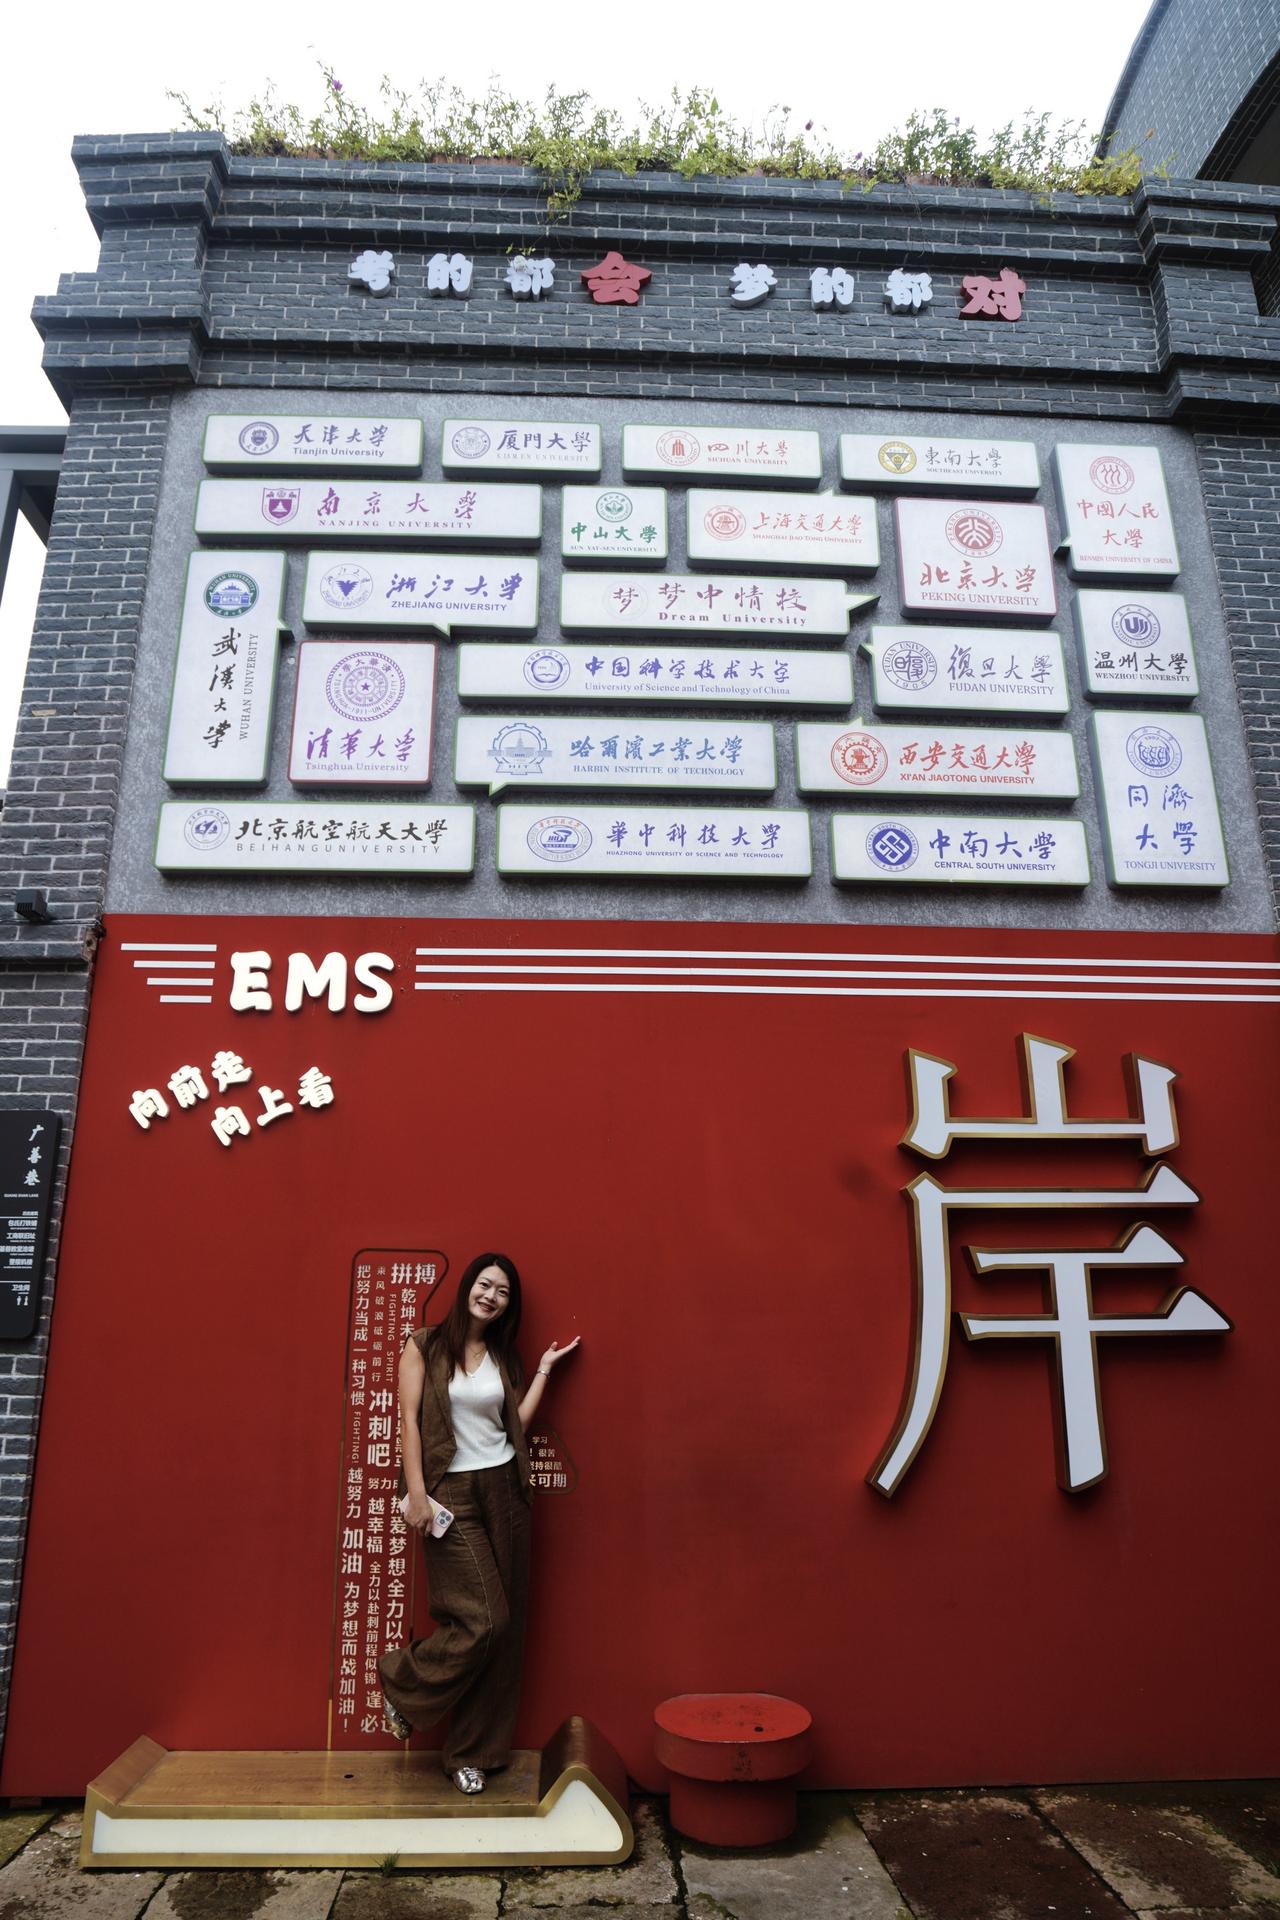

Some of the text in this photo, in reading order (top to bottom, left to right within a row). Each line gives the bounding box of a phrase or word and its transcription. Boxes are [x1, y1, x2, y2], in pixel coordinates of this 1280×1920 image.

[293, 447, 384, 458] Tianjin University
[707, 456, 788, 466] SICHUAN UNIVERSITY
[319, 519, 474, 529] NANJING UNIVERSITY
[391, 600, 507, 612] ZHEJIANG UNIVERSITY
[658, 582, 808, 611] 梦中情校
[921, 591, 1040, 607] PEKING UNIVERSITY
[658, 612, 806, 627] Dream University
[1095, 672, 1191, 682] WENZHOU UNIVERSITY
[239, 633, 260, 741] WUHAN UNIVERSITY
[585, 681, 790, 696] University of Science and Technology of China
[949, 682, 1055, 696] FUDAN UNIVERSITY
[305, 762, 410, 773] Tsinghua University
[573, 764, 745, 776] HARBIN INSTITUTE OF TECHNOLOGY
[900, 773, 1035, 784] XI'AN JIAOTONG UNIVERSITY
[934, 861, 1056, 871] CENTRAL SOUTH UNIVERSITY
[1124, 860, 1217, 871] TONGJI UNIVERSITY
[229, 950, 395, 1013] EMS
[129, 1050, 253, 1130] 向前走
[211, 1066, 335, 1147] 向上看
[390, 1263, 437, 1285] 拼搏
[865, 1031, 1235, 1499] 岸
[350, 1264, 372, 1407] 把努力当成一种习惯
[386, 1293, 397, 1383] FIGHTING SPIRIT
[367, 1387, 393, 1468] 冲刺吧
[351, 1411, 362, 1465] FIGHTING!
[346, 1467, 364, 1519] 越努力
[366, 1497, 385, 1554] 越幸福
[341, 1526, 364, 1575] 加油
